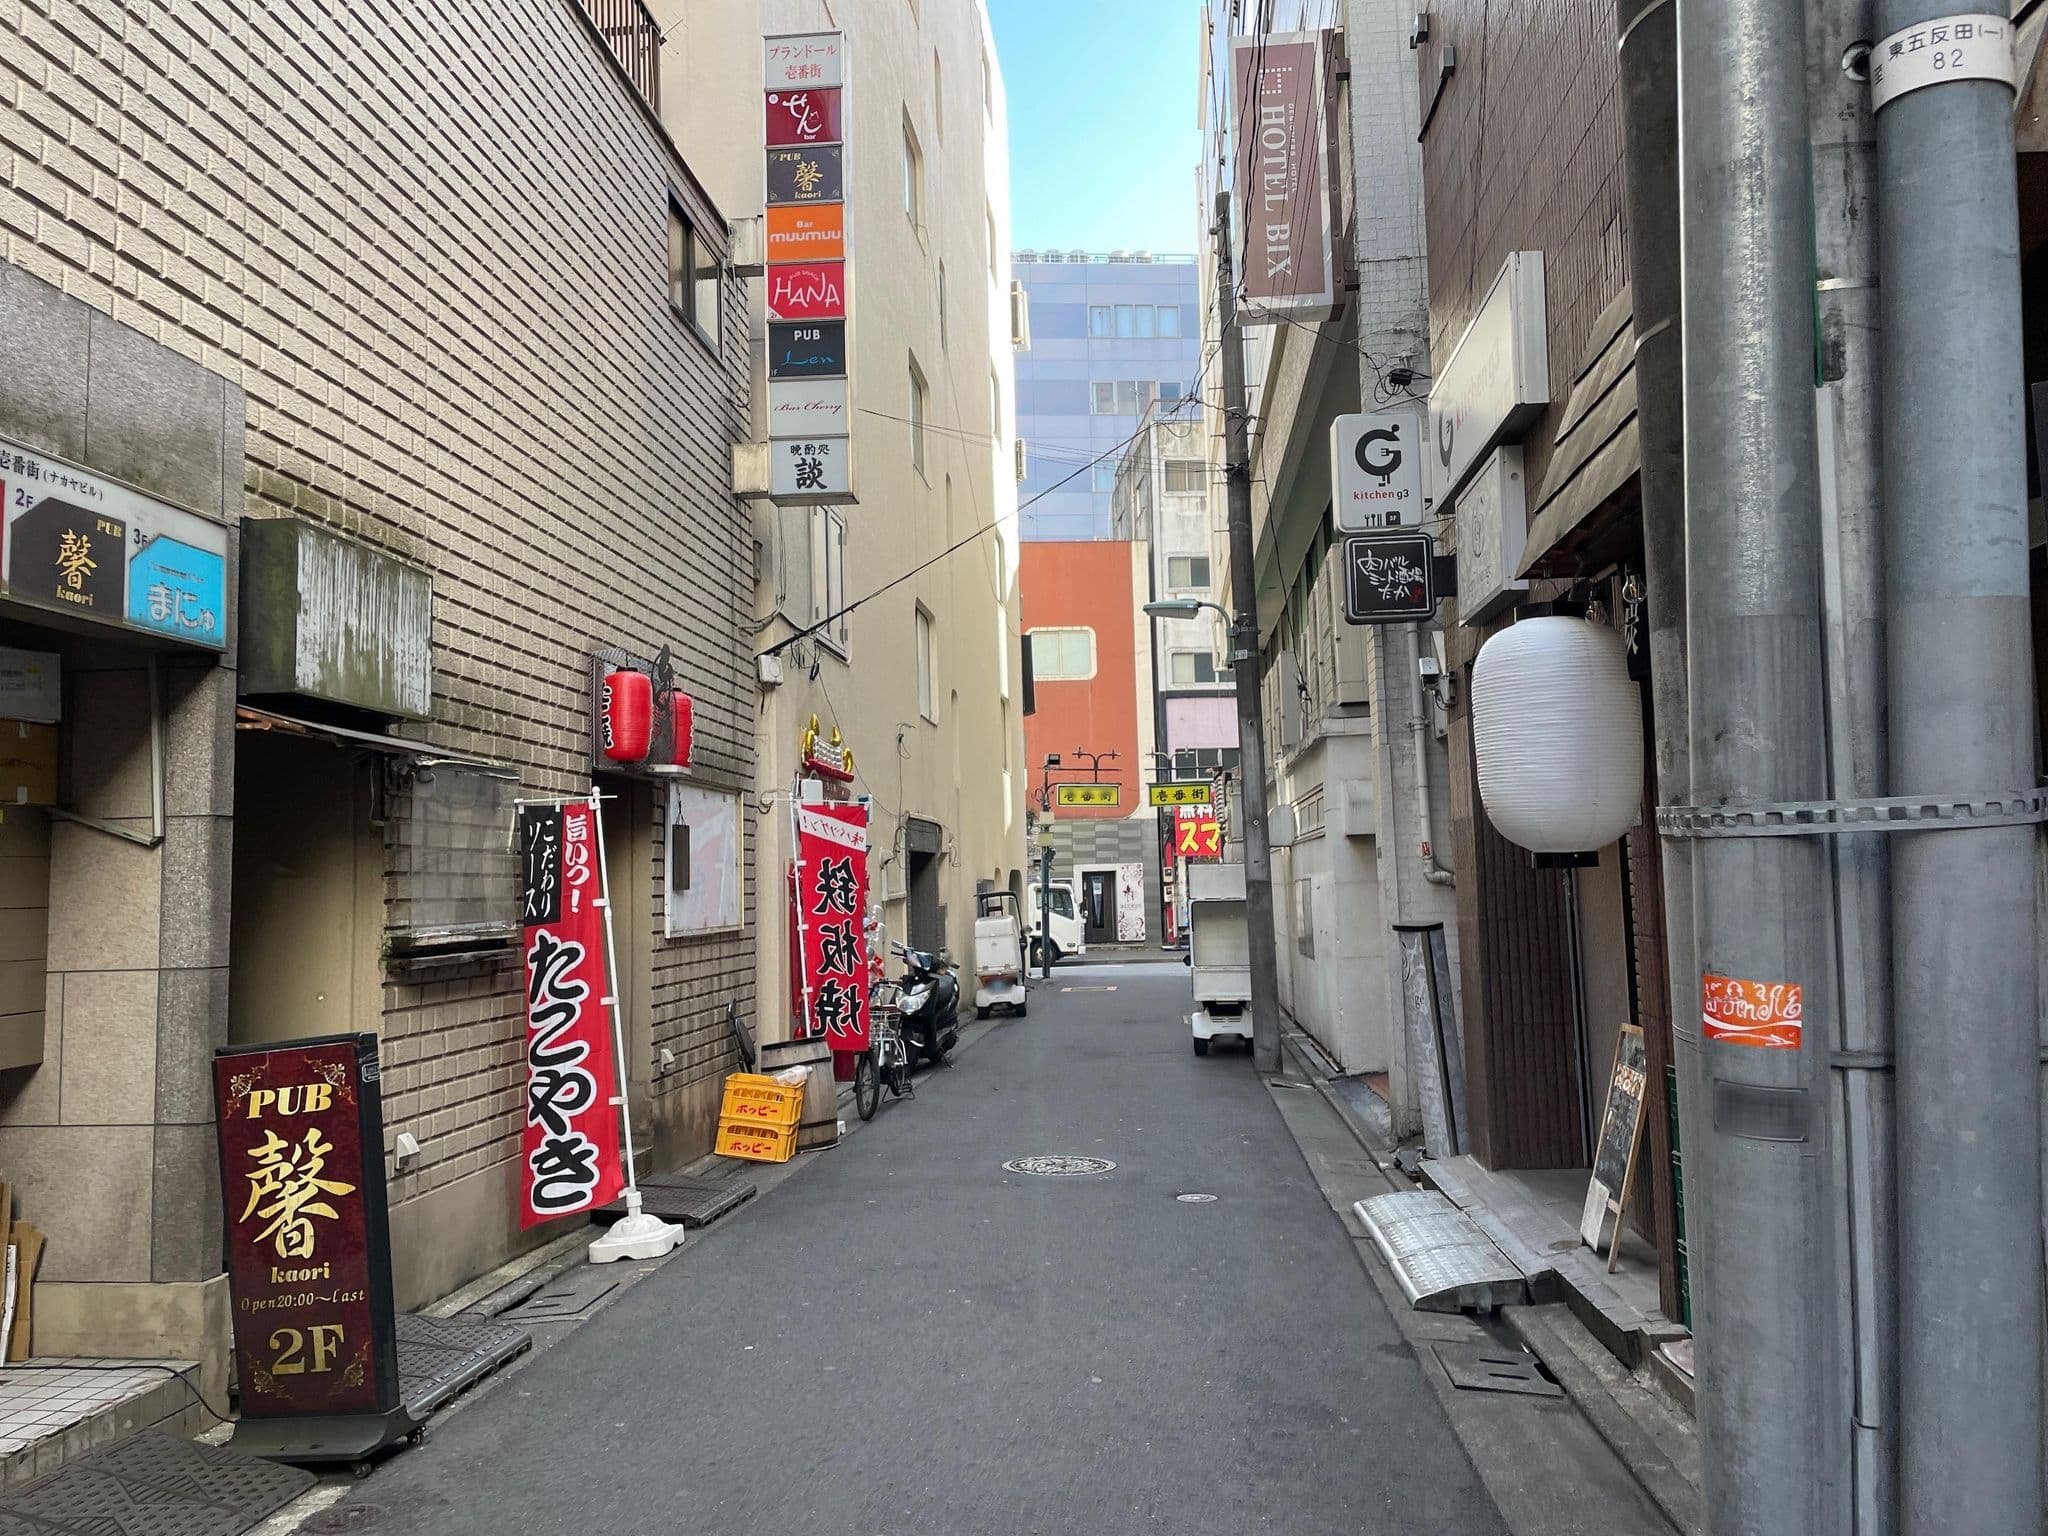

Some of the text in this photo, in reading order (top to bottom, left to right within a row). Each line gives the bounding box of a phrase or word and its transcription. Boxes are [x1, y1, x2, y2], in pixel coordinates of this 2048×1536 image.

[769, 46, 836, 60] ブランドール
[1933, 49, 1964, 70] 82
[785, 64, 822, 80] 壱番街
[779, 152, 801, 161] PUB
[794, 191, 822, 199] kaori
[1260, 104, 1292, 279] HOTEL BIX
[796, 220, 814, 228] Bar
[769, 230, 841, 242] muumuu
[773, 272, 841, 308] HANA
[793, 329, 821, 341] PUB
[794, 457, 828, 490] 談
[15, 487, 34, 509] 2F
[1353, 489, 1409, 500] kitchen g3
[96, 519, 122, 538] PUB
[133, 529, 148, 546] 3F
[55, 584, 94, 607] kaori
[528, 928, 600, 1215] たこやき
[246, 1082, 334, 1120] PUB
[271, 1261, 331, 1285] kaori
[269, 1323, 345, 1376] 2F
